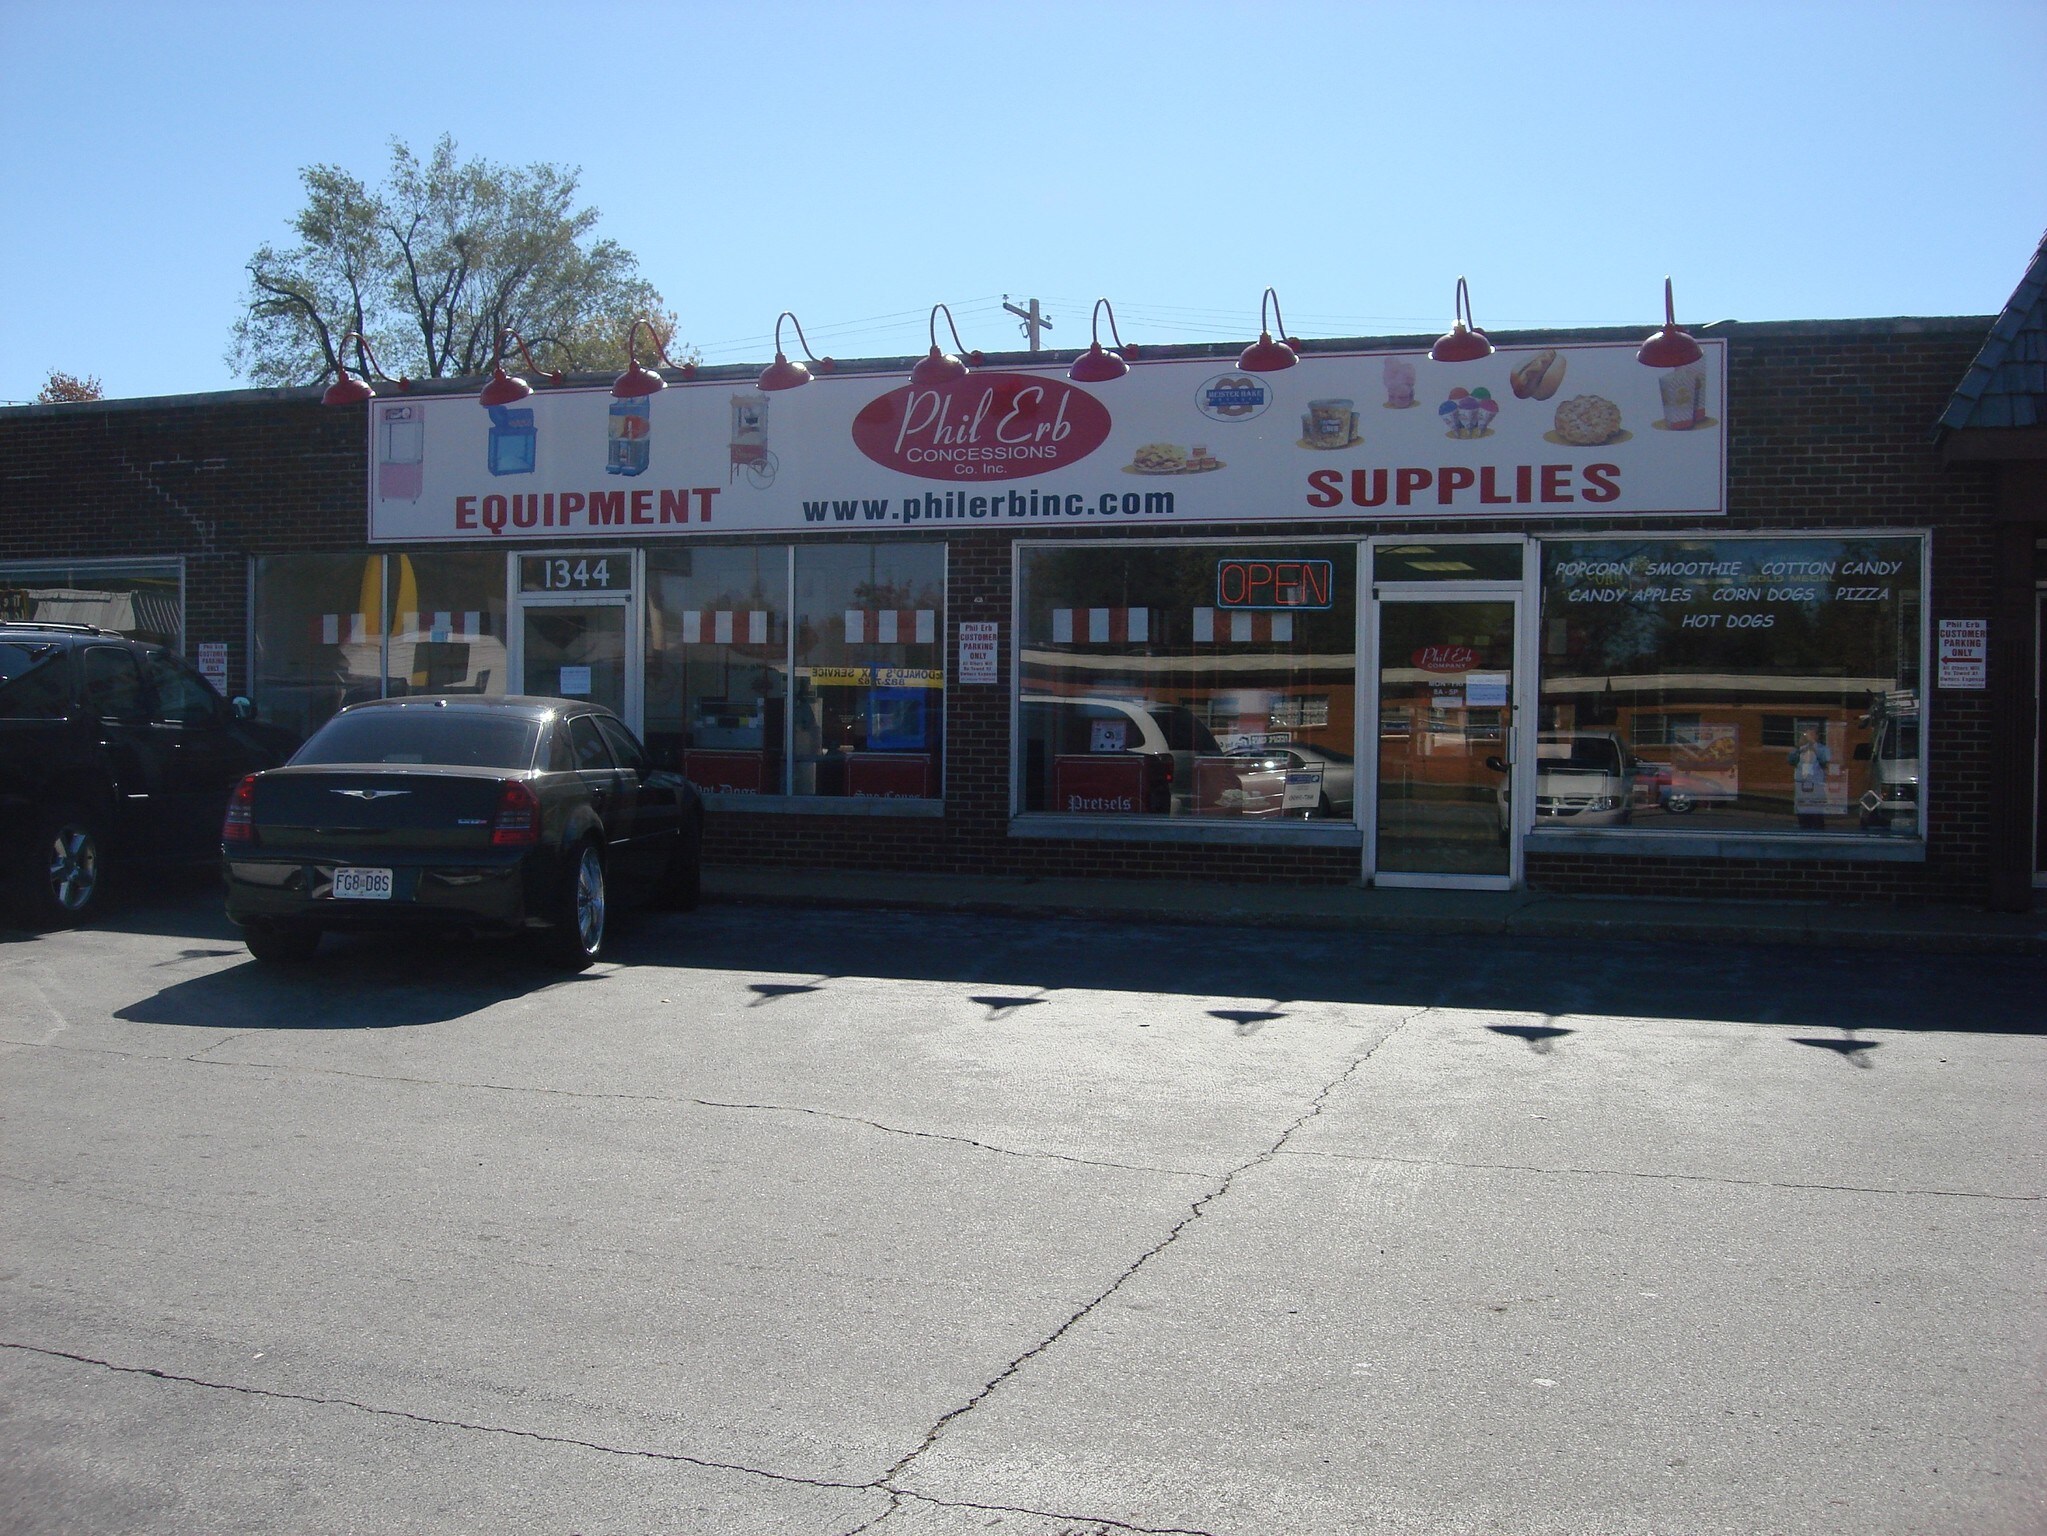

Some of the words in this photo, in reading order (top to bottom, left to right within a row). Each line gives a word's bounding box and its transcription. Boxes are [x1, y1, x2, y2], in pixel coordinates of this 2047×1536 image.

[894, 386, 994, 453] Phil
[996, 385, 1072, 442] Erb
[907, 446, 1057, 463] CONCESSIONS
[954, 464, 978, 476] Co.
[982, 463, 1007, 475] Inc.
[1306, 463, 1621, 508] SUPPLIES
[455, 487, 721, 534] EQUIPMENT
[803, 489, 1175, 524] www.philerbinc.com
[545, 559, 610, 589] 1344
[1555, 562, 1634, 576] POPCORN
[1645, 561, 1743, 576] SMOOTHIE
[1761, 561, 1837, 575] COTTON
[1842, 561, 1902, 576] CANDY
[1220, 564, 1328, 605] OPEN
[1568, 588, 1626, 602] CANDY
[1632, 588, 1692, 602] APPLES
[1712, 587, 1762, 602] CORN
[1766, 587, 1815, 602] DOGS
[1835, 587, 1889, 601] PIZZA
[1682, 614, 1721, 628] HOT
[1725, 614, 1775, 628] DOGS
[960, 633, 997, 641] CUSTOMER
[1940, 630, 1986, 638] CUSTOMER
[1944, 639, 1981, 647] PARKING
[970, 652, 987, 660] ONLY
[1421, 647, 1450, 664] Phil
[1452, 647, 1472, 662] Erb
[1952, 649, 1973, 657] ONLY
[1067, 794, 1133, 812] Pretzels
[336, 874, 360, 890] FG8
[365, 875, 390, 891] D8S
